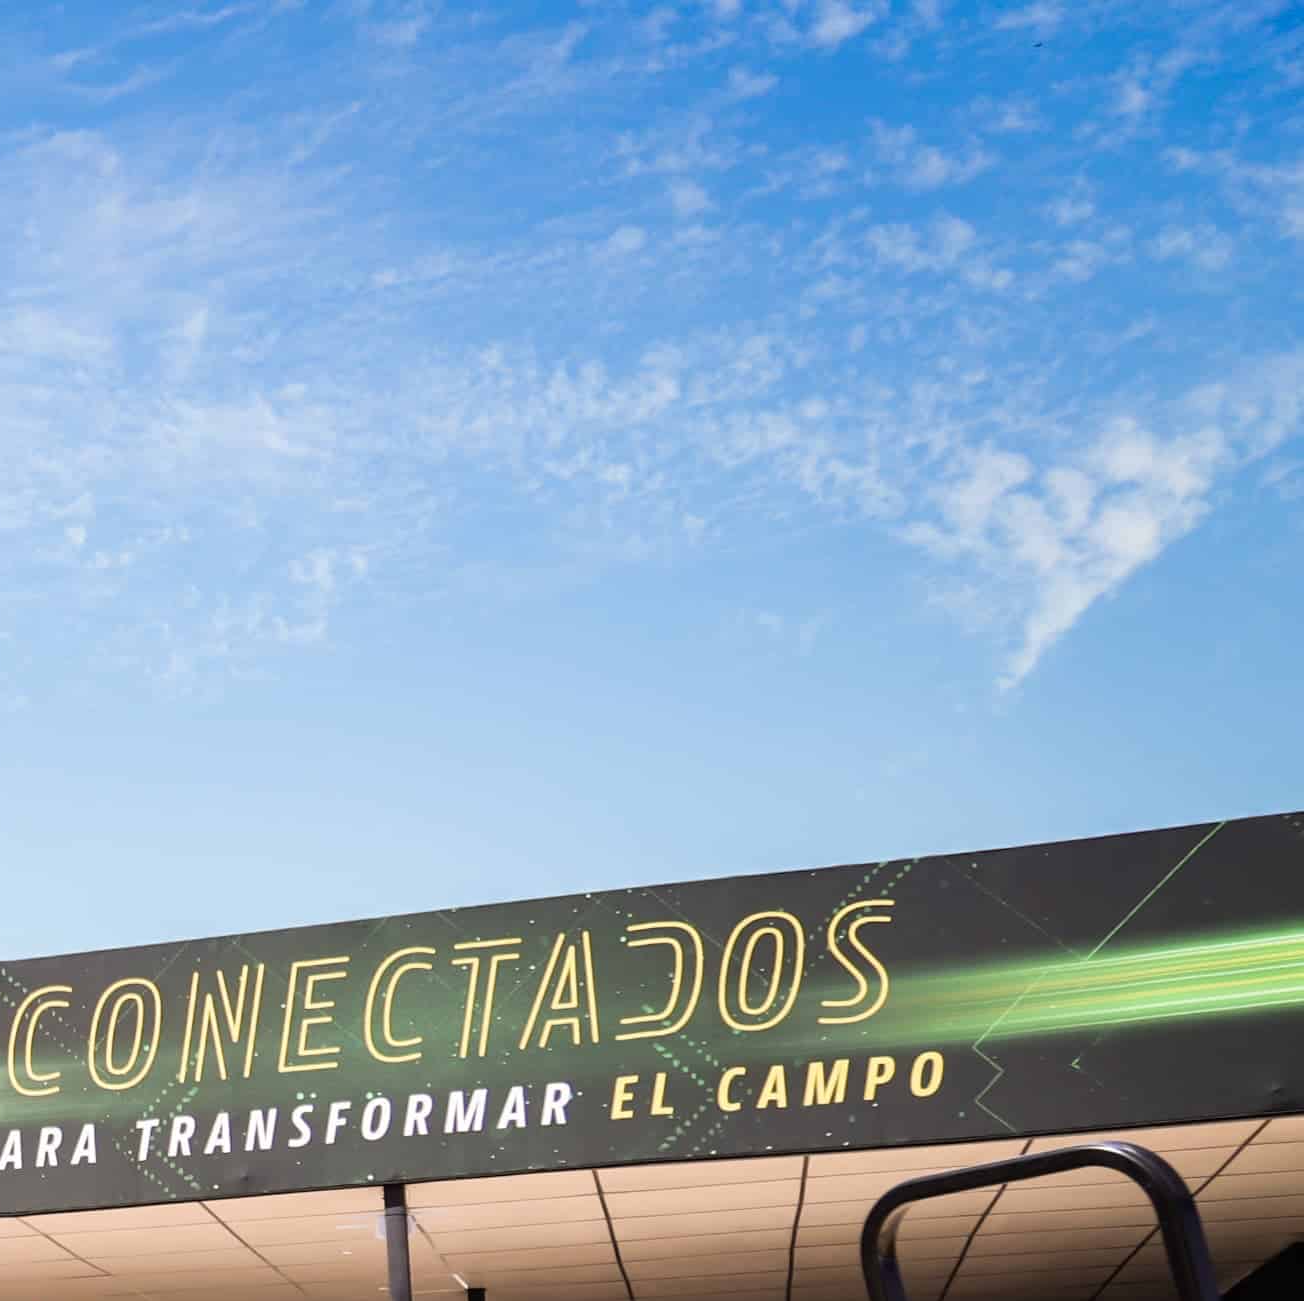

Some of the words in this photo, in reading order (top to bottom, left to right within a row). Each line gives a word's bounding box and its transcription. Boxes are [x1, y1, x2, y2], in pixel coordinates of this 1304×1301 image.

[7, 899, 895, 1096] CONECTADOS
[135, 1081, 574, 1162] TRANSFORMAR
[610, 1072, 676, 1120] EL
[717, 1051, 945, 1112] CAMPO
